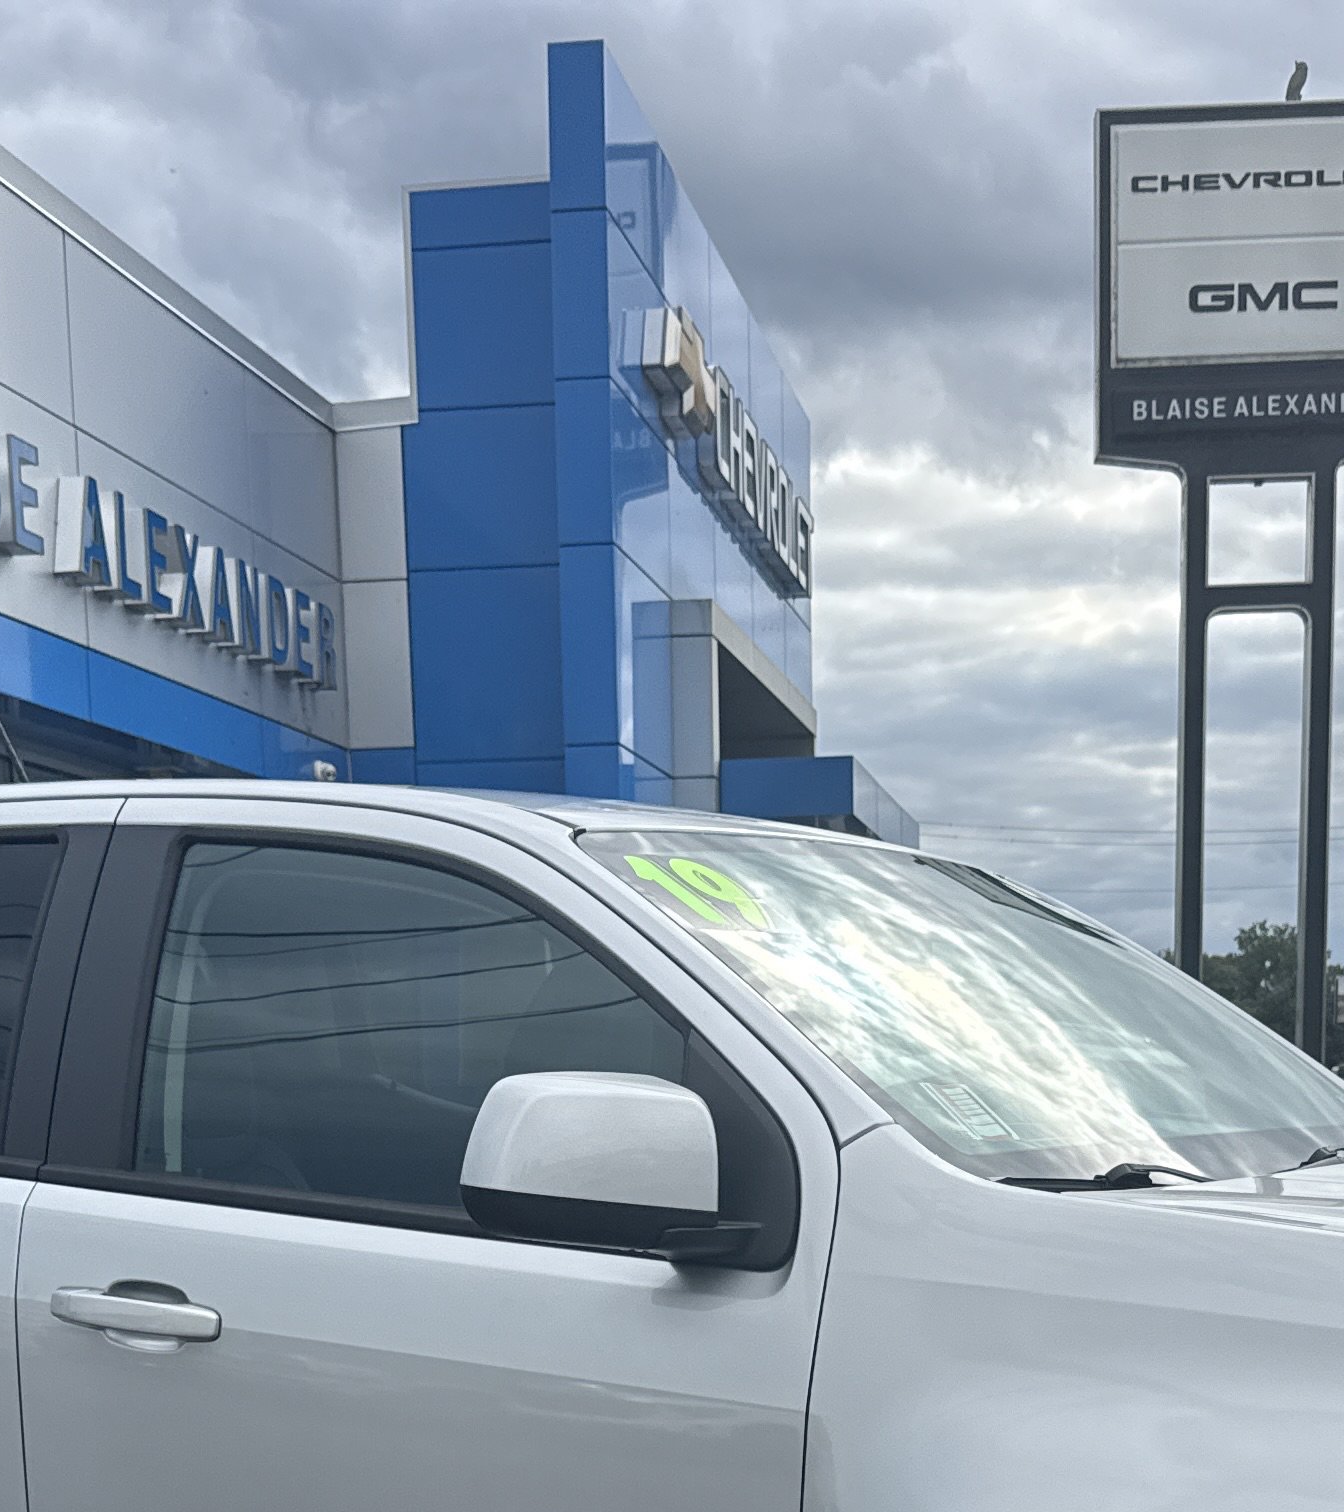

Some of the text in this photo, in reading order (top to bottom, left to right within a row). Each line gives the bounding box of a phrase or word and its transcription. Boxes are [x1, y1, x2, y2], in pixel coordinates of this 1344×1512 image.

[1188, 279, 1339, 314] GMC
[1132, 396, 1228, 422] BLAISE
[55, 474, 339, 691] ALEXANDER
[622, 854, 770, 932] 19
